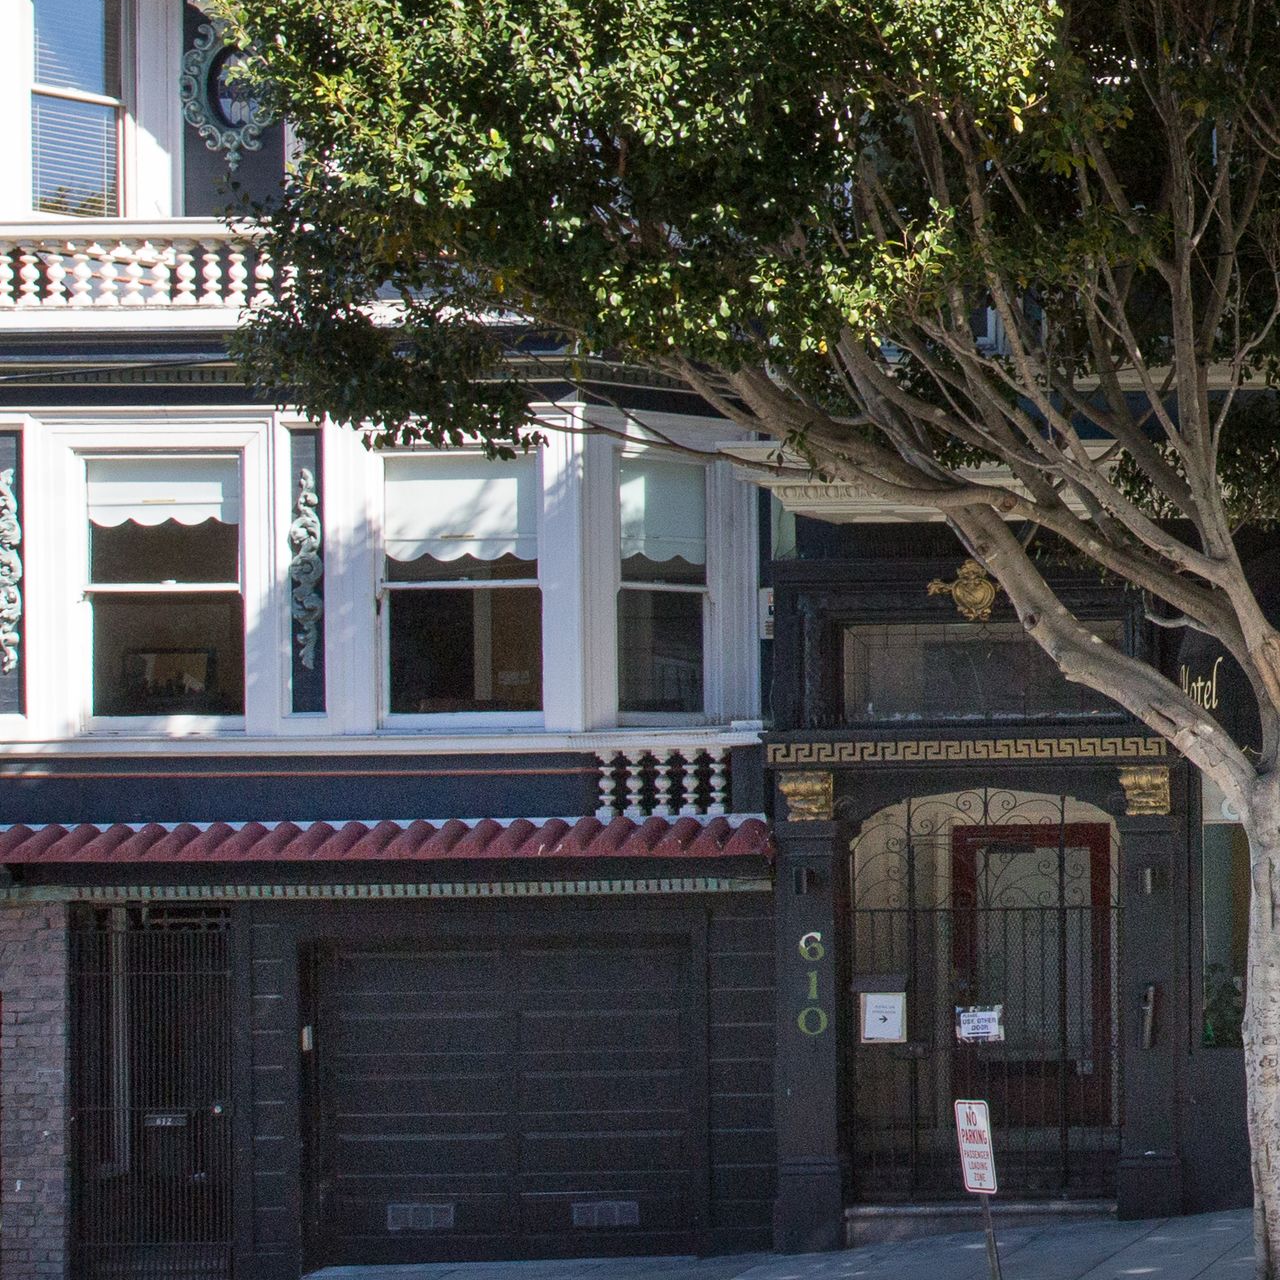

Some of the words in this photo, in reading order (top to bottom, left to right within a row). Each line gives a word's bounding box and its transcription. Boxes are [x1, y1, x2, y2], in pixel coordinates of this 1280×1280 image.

[797, 932, 828, 1035] 610
[965, 1111, 978, 1127] NO
[961, 1129, 988, 1145] PARKING
[963, 1150, 990, 1160] PASSENGER
[968, 1161, 988, 1171] LOADING
